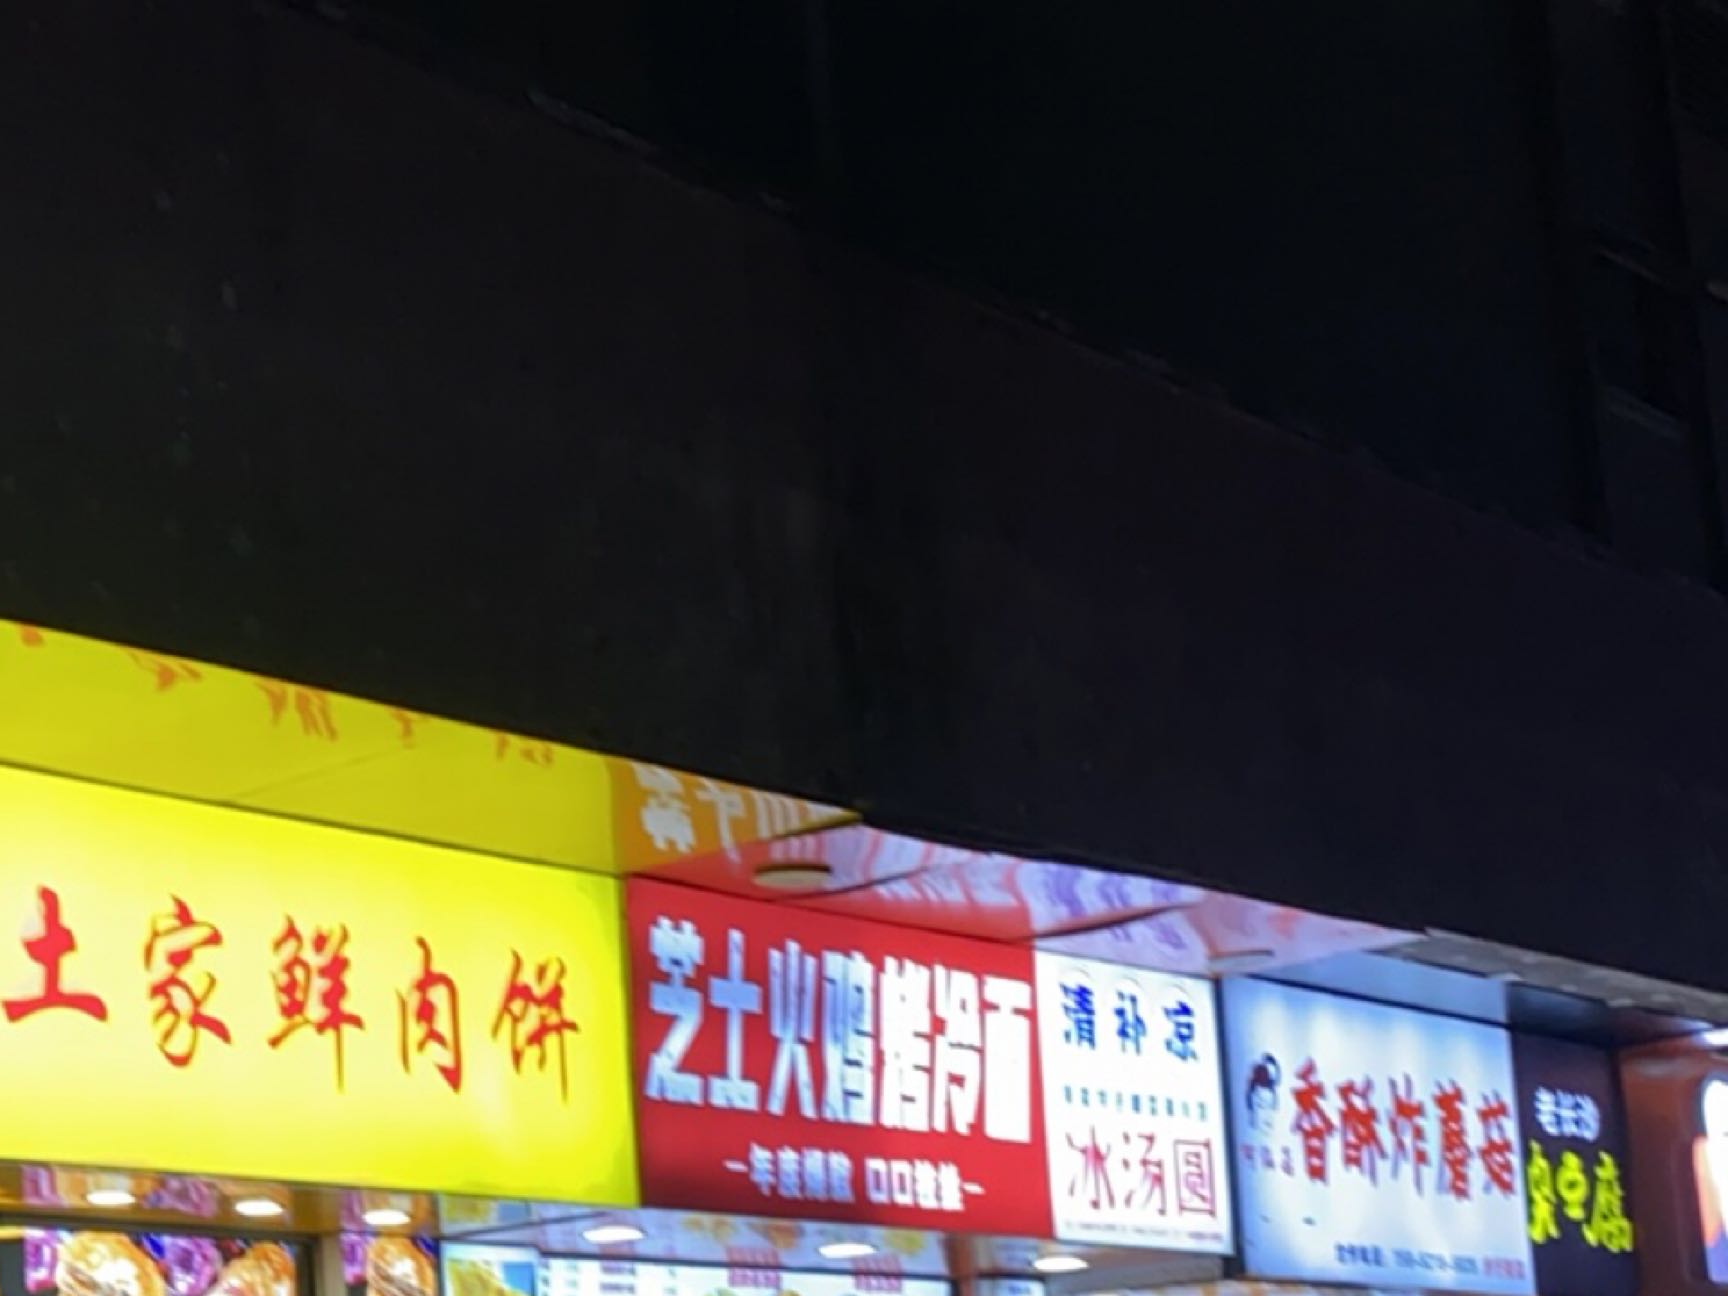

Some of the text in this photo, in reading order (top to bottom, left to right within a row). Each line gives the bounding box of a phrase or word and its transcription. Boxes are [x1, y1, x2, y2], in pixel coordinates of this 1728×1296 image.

[2, 884, 580, 1103] 土家鲜肉饼
[1059, 981, 1199, 1062] 清补凉
[1065, 1125, 1216, 1218] 冰汤圆
[1290, 1056, 1516, 1201] 香酥炸蘑菇
